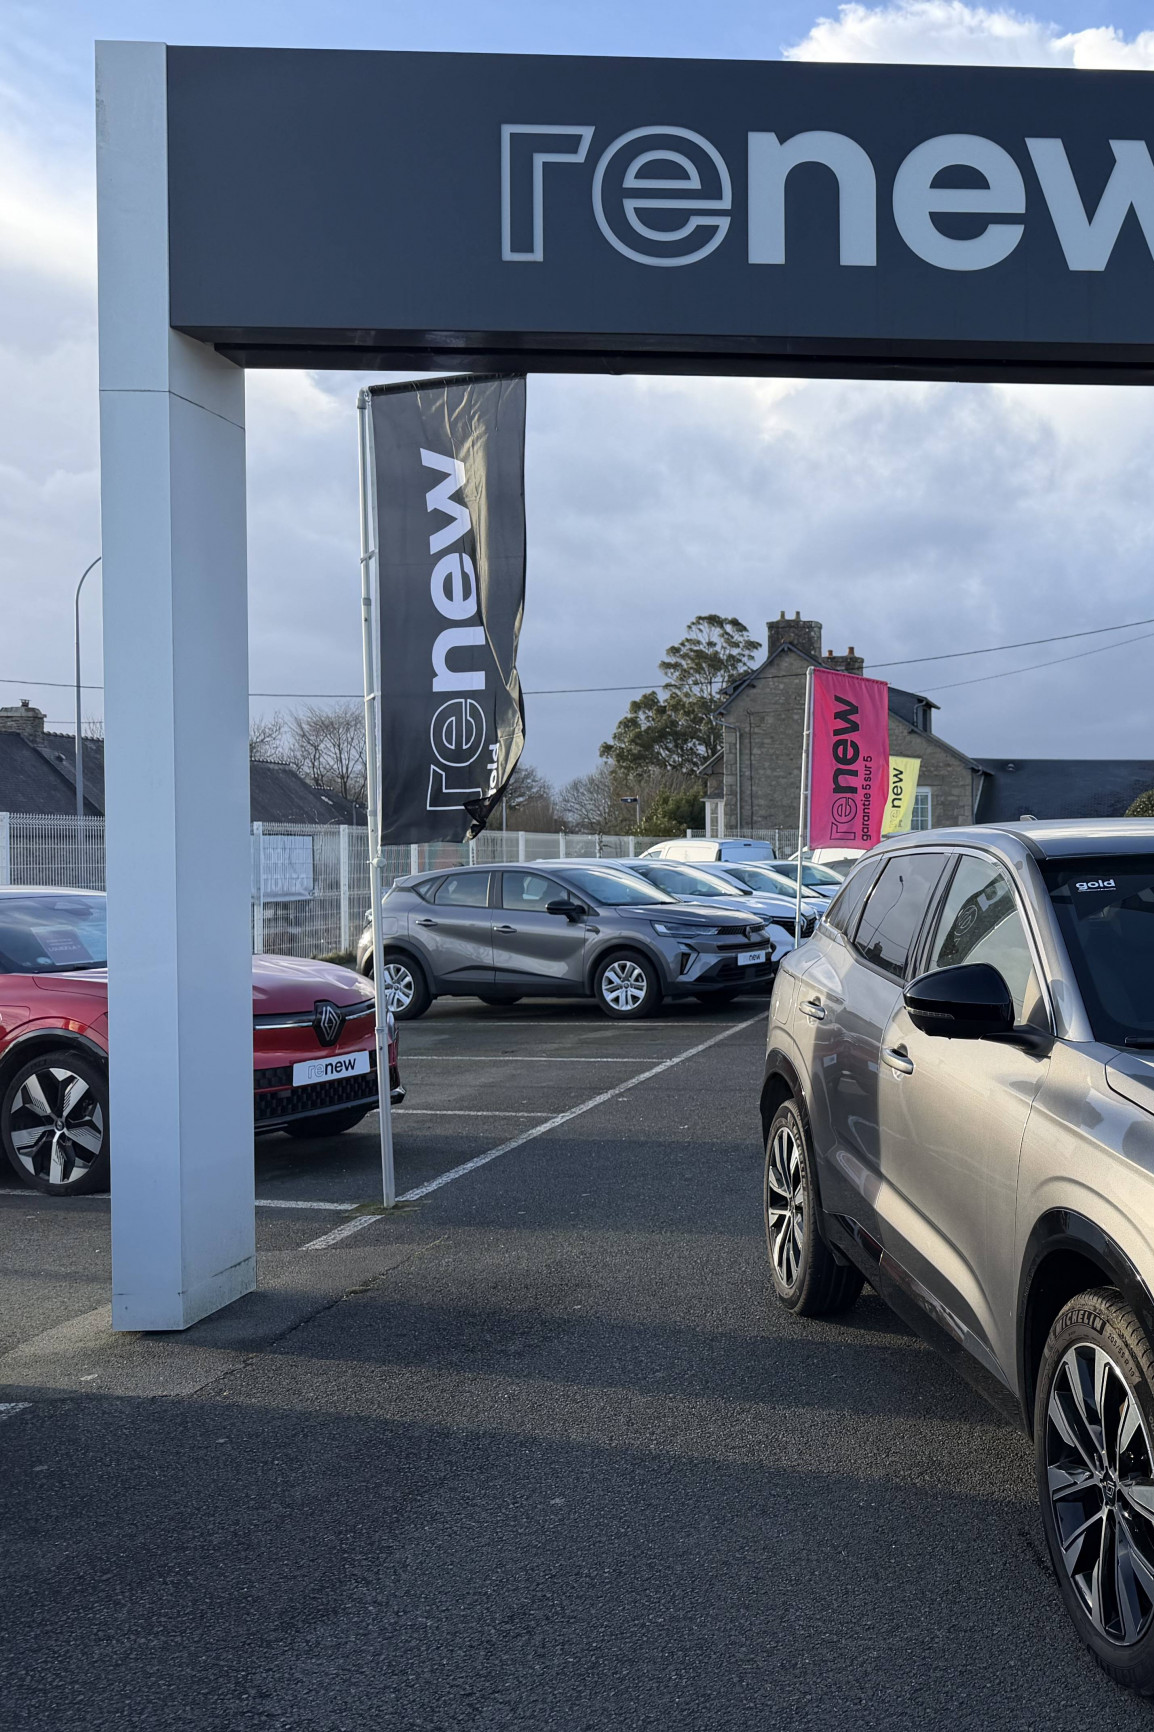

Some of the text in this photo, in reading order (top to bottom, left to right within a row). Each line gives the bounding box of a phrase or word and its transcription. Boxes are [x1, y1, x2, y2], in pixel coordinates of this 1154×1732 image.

[419, 448, 487, 812] renew
[830, 695, 860, 841] renew
[863, 764, 872, 783] sur
[861, 793, 872, 842] garantie
[1075, 879, 1116, 891] gold
[308, 1058, 356, 1079] renew
[1054, 1309, 1104, 1337] MICHELIN
